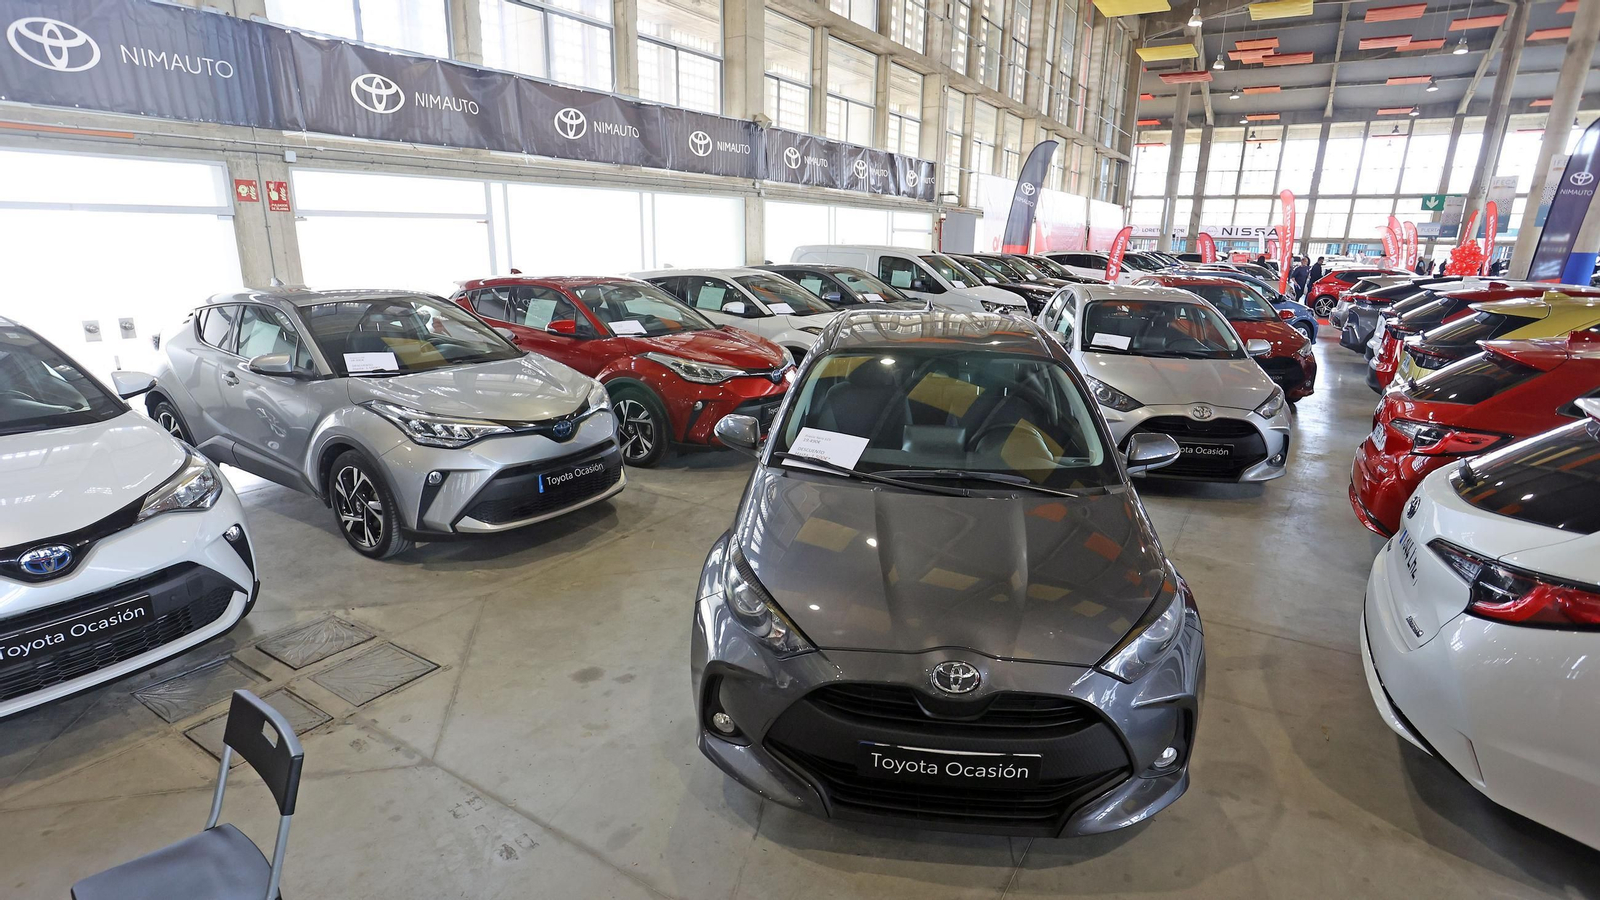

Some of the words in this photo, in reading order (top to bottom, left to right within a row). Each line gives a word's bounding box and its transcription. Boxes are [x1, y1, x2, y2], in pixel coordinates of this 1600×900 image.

[119, 44, 234, 78] NIMAUTO
[415, 91, 479, 115] NIMAUTO
[593, 121, 640, 138] NIMAUTO
[716, 141, 750, 155] NIMAUTO
[1560, 188, 1593, 197] NIMAUTO
[1221, 227, 1278, 236] NISSA
[1111, 236, 1125, 264] driveris
[1195, 446, 1229, 456] Ocasión
[546, 472, 574, 486] Toyota
[574, 463, 604, 477] Ocasión
[0, 631, 65, 660] Toyota
[70, 607, 145, 637] Ocasión
[871, 752, 938, 774] Toyota
[945, 762, 1029, 779] Ocasión
